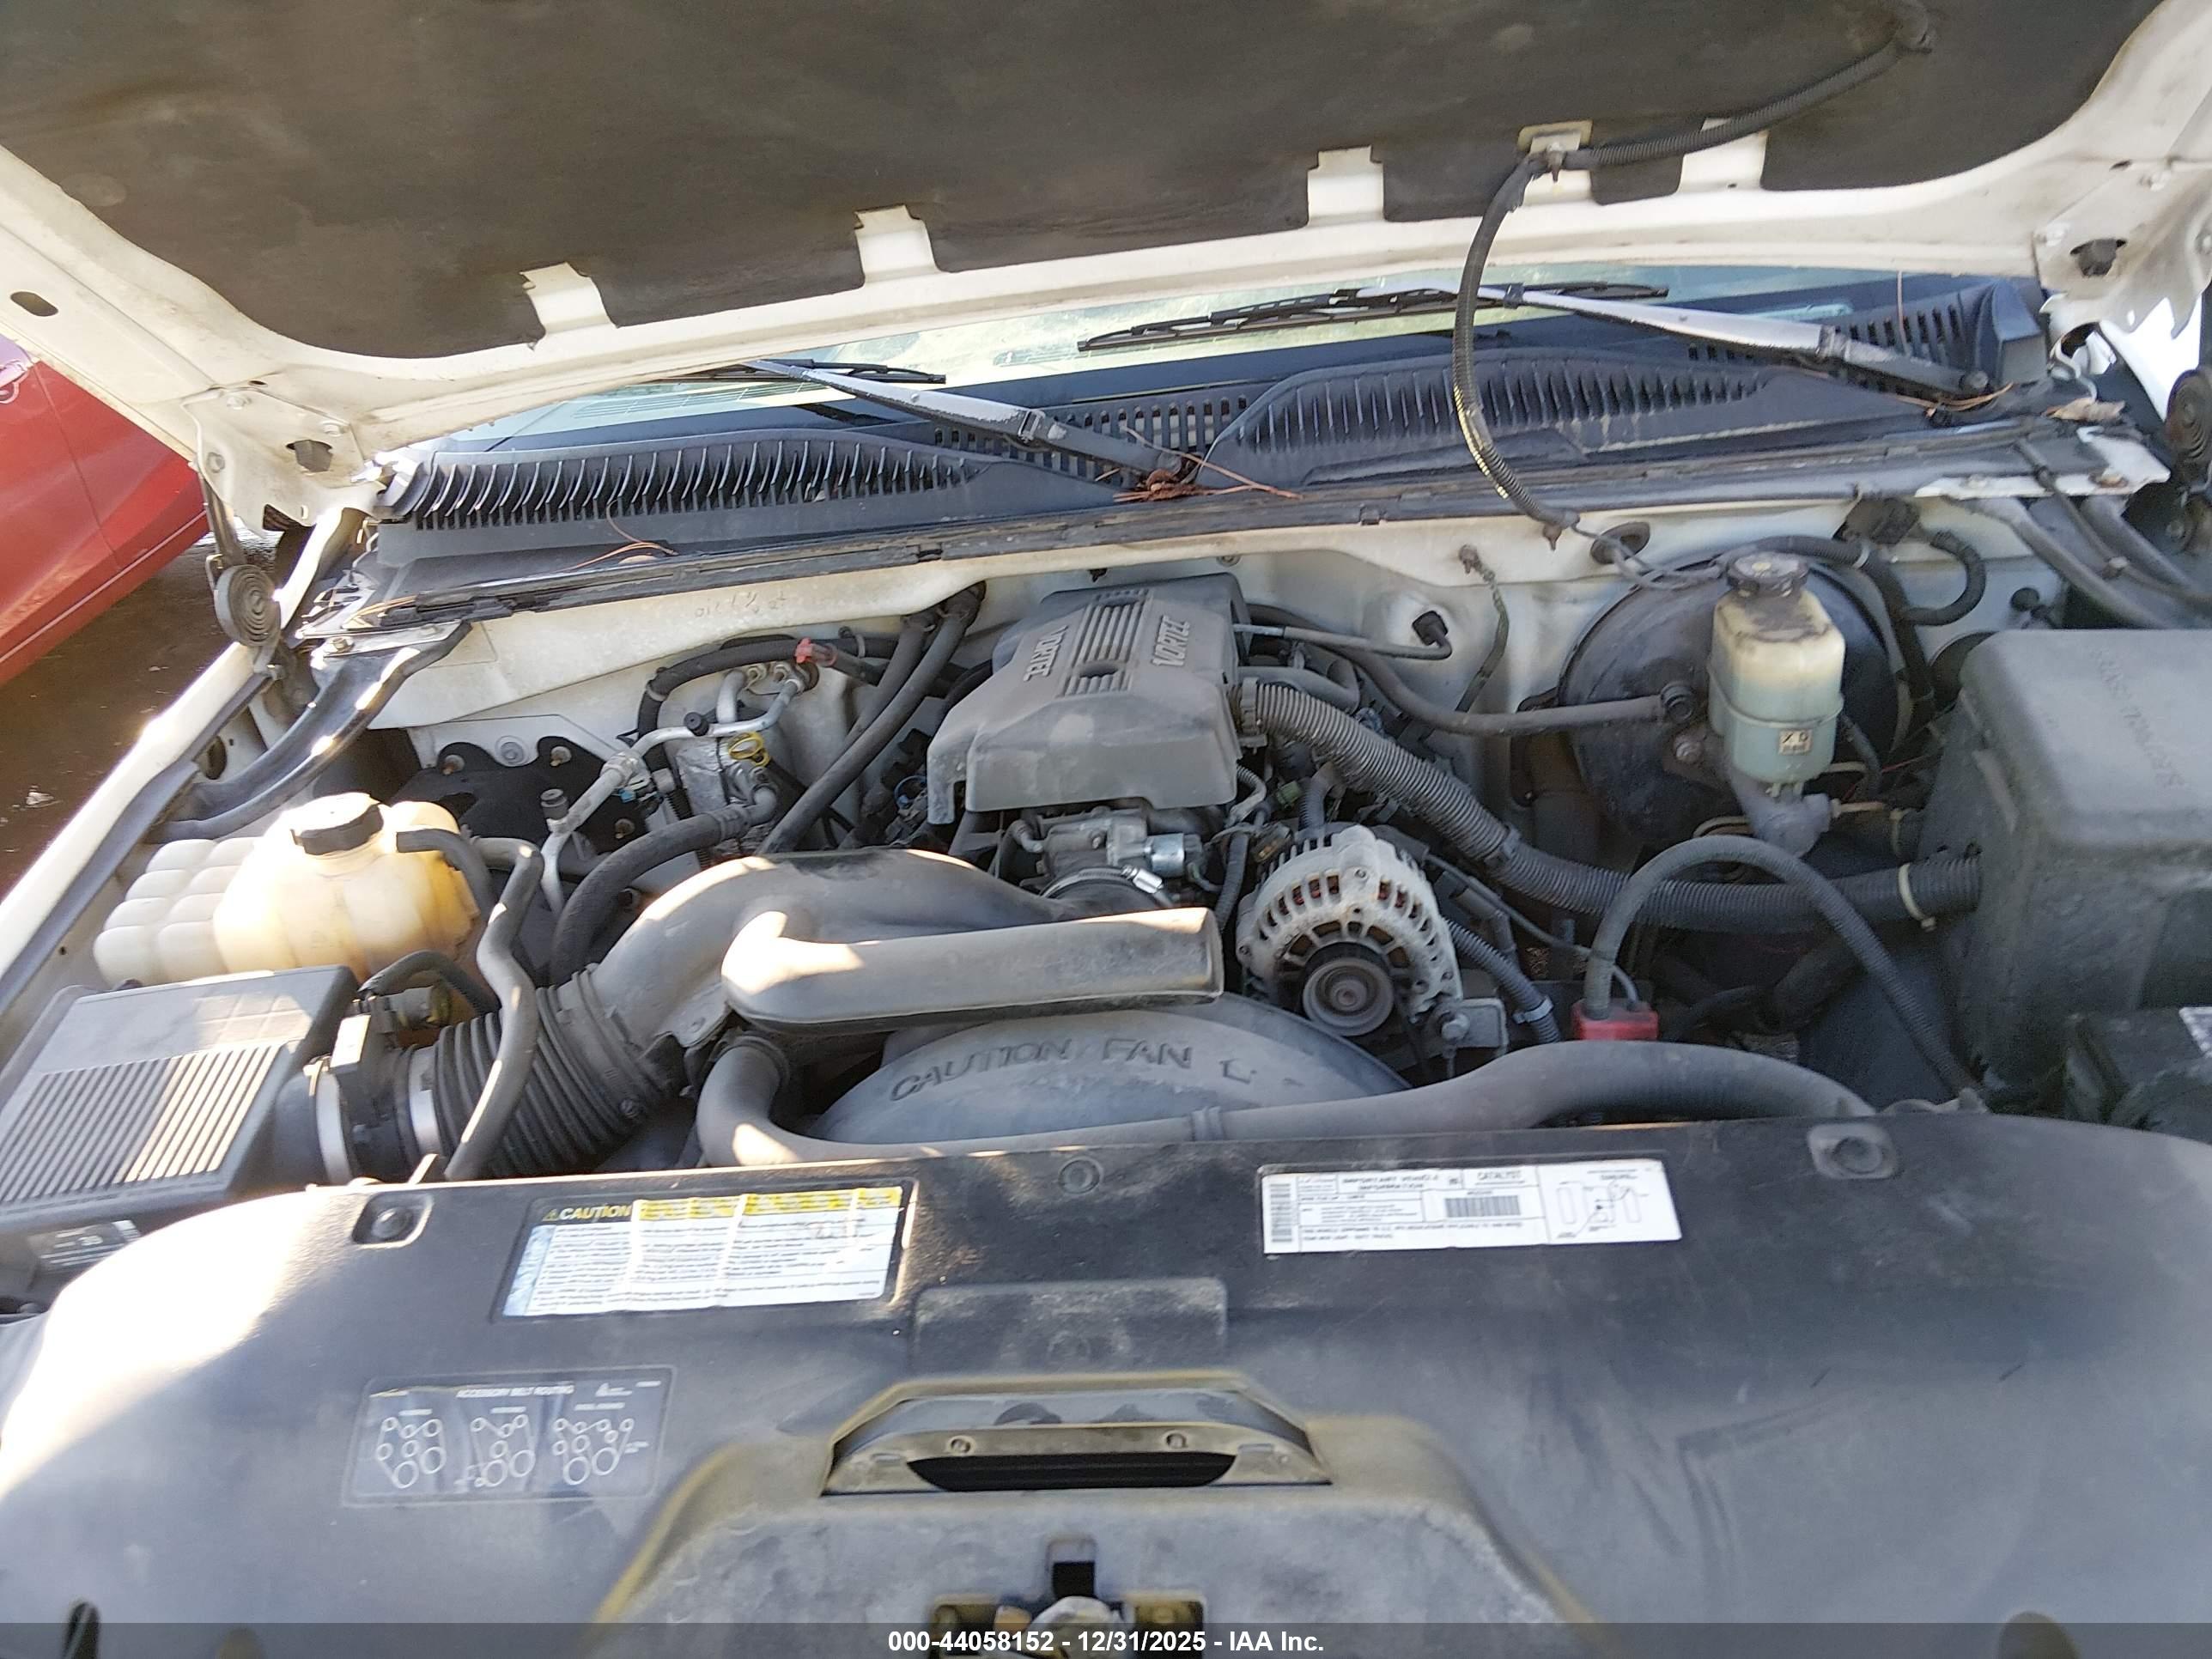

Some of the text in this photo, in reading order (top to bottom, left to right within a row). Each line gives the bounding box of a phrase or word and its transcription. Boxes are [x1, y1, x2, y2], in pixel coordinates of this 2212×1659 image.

[1023, 625, 1069, 683] VORTEC
[1152, 613, 1192, 668] VORTEC
[890, 1036, 1071, 1103] CAUTION
[1100, 1036, 1194, 1069] FAN
[558, 1204, 633, 1221] CAUTION
